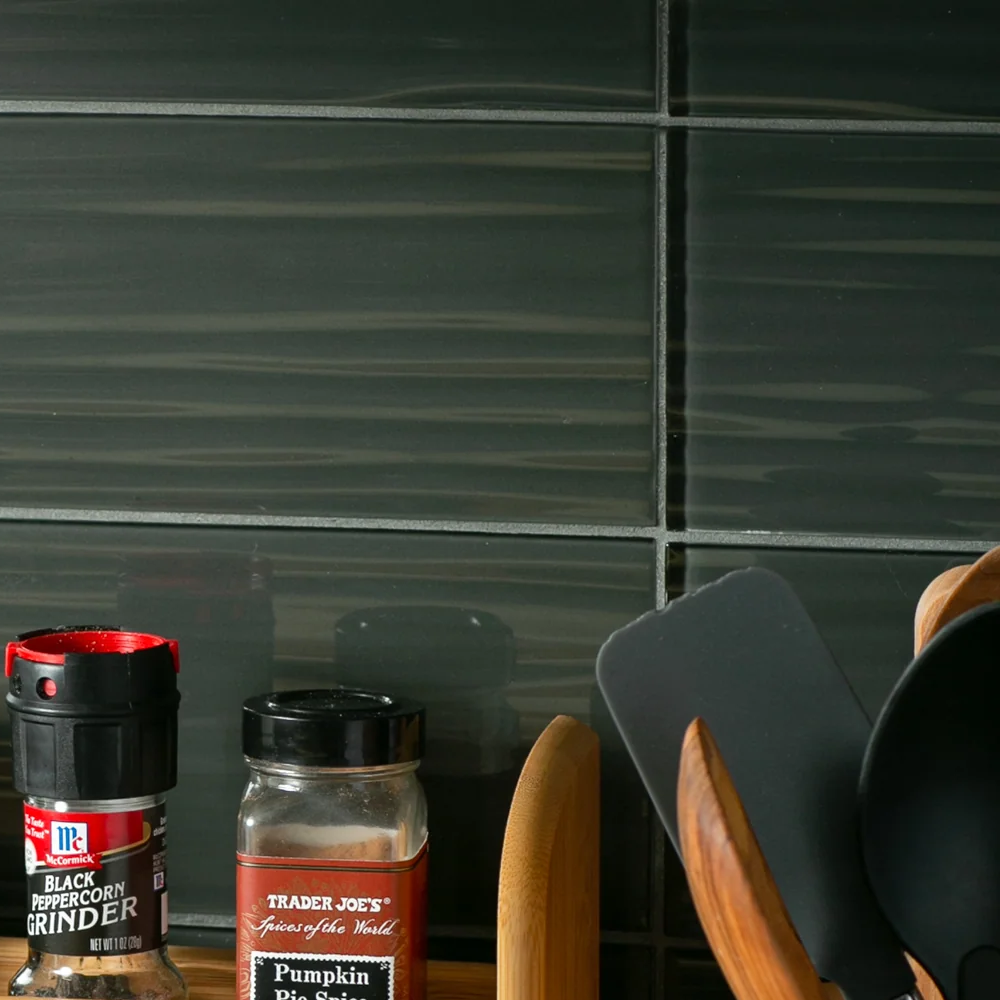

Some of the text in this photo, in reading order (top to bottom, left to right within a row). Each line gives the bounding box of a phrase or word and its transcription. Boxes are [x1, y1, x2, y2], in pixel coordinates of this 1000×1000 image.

[45, 853, 95, 866] McCormick
[44, 871, 96, 893] BLACK
[31, 881, 126, 912] PEPPERCORN
[266, 894, 333, 912] TRADER
[27, 896, 138, 936] GRINDER
[250, 915, 401, 941] Spices of the World
[90, 938, 102, 951] NET
[103, 937, 113, 951] WT
[114, 937, 118, 950] 1
[119, 936, 128, 950] OZ
[273, 963, 370, 987] Pumpkin
